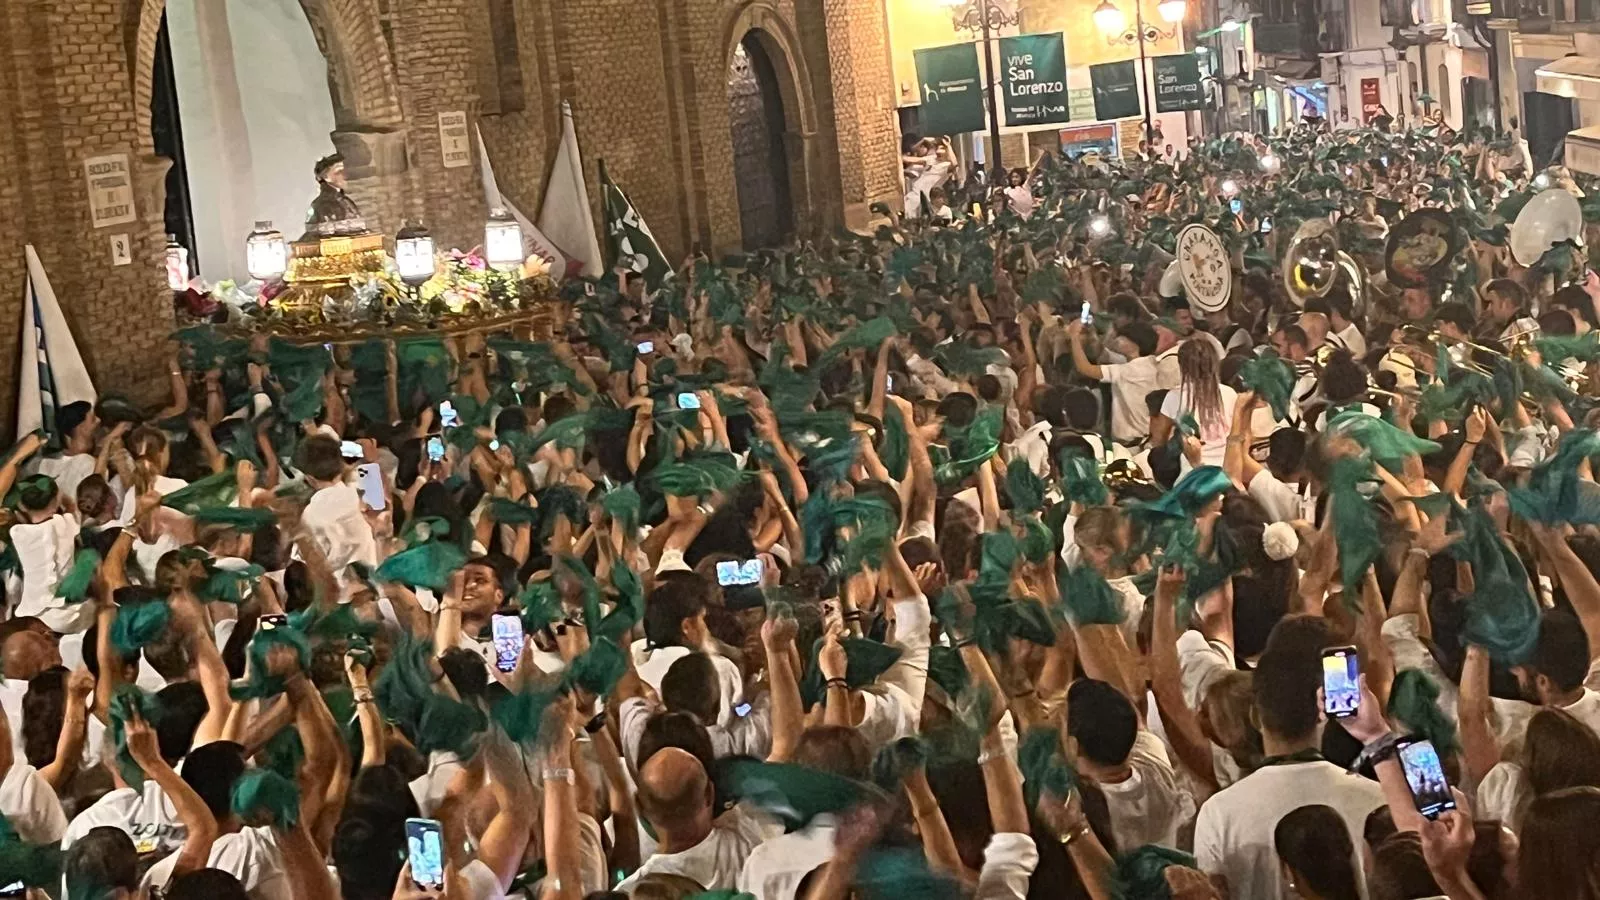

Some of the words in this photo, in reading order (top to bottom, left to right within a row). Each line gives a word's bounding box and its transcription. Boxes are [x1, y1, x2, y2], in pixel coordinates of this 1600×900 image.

[1007, 54, 1033, 66] vive
[1008, 67, 1035, 81] San
[1010, 81, 1064, 96] Lorenzo
